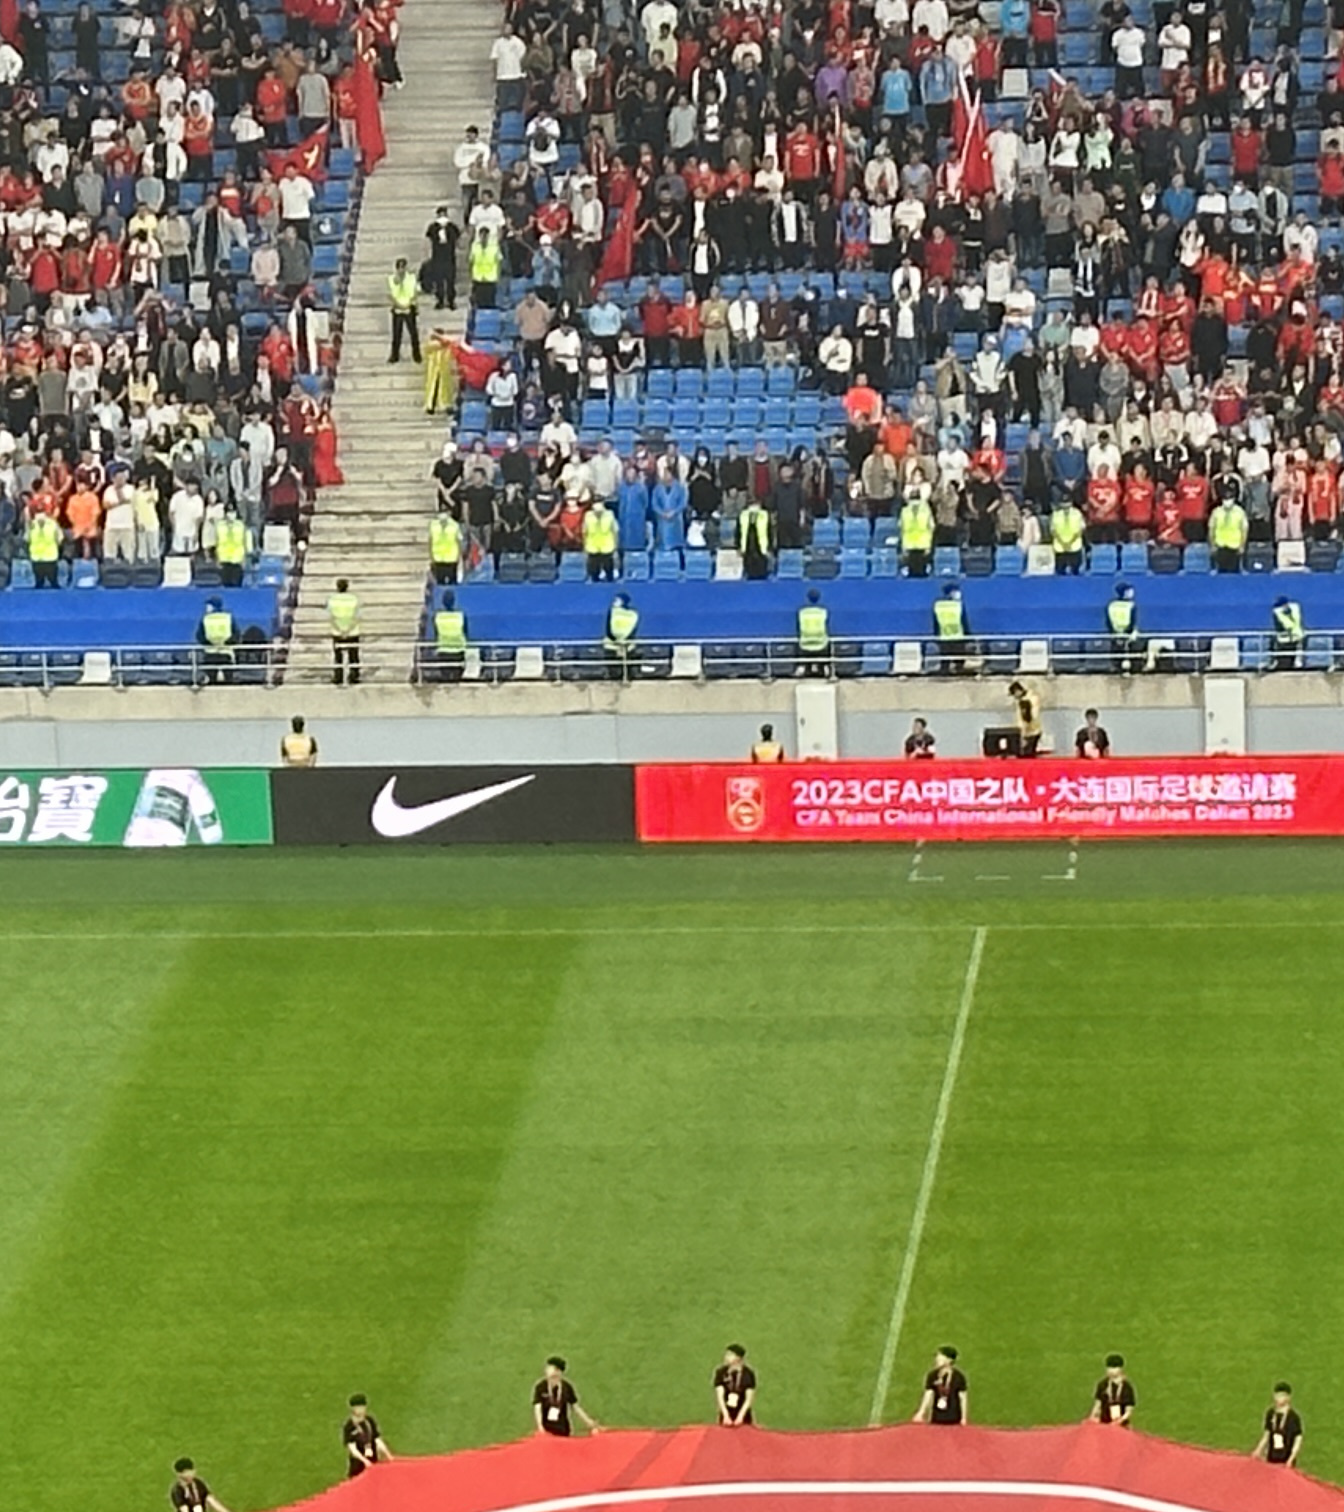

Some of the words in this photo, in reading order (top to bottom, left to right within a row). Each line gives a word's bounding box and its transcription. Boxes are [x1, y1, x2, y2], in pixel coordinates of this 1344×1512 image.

[795, 810, 832, 826] CFA
[834, 809, 881, 826] Team
[883, 809, 933, 826] China
[937, 807, 1043, 826] International
[1047, 806, 1117, 826] Friendly
[1119, 806, 1192, 822] Matches
[1252, 804, 1294, 821] 2023
